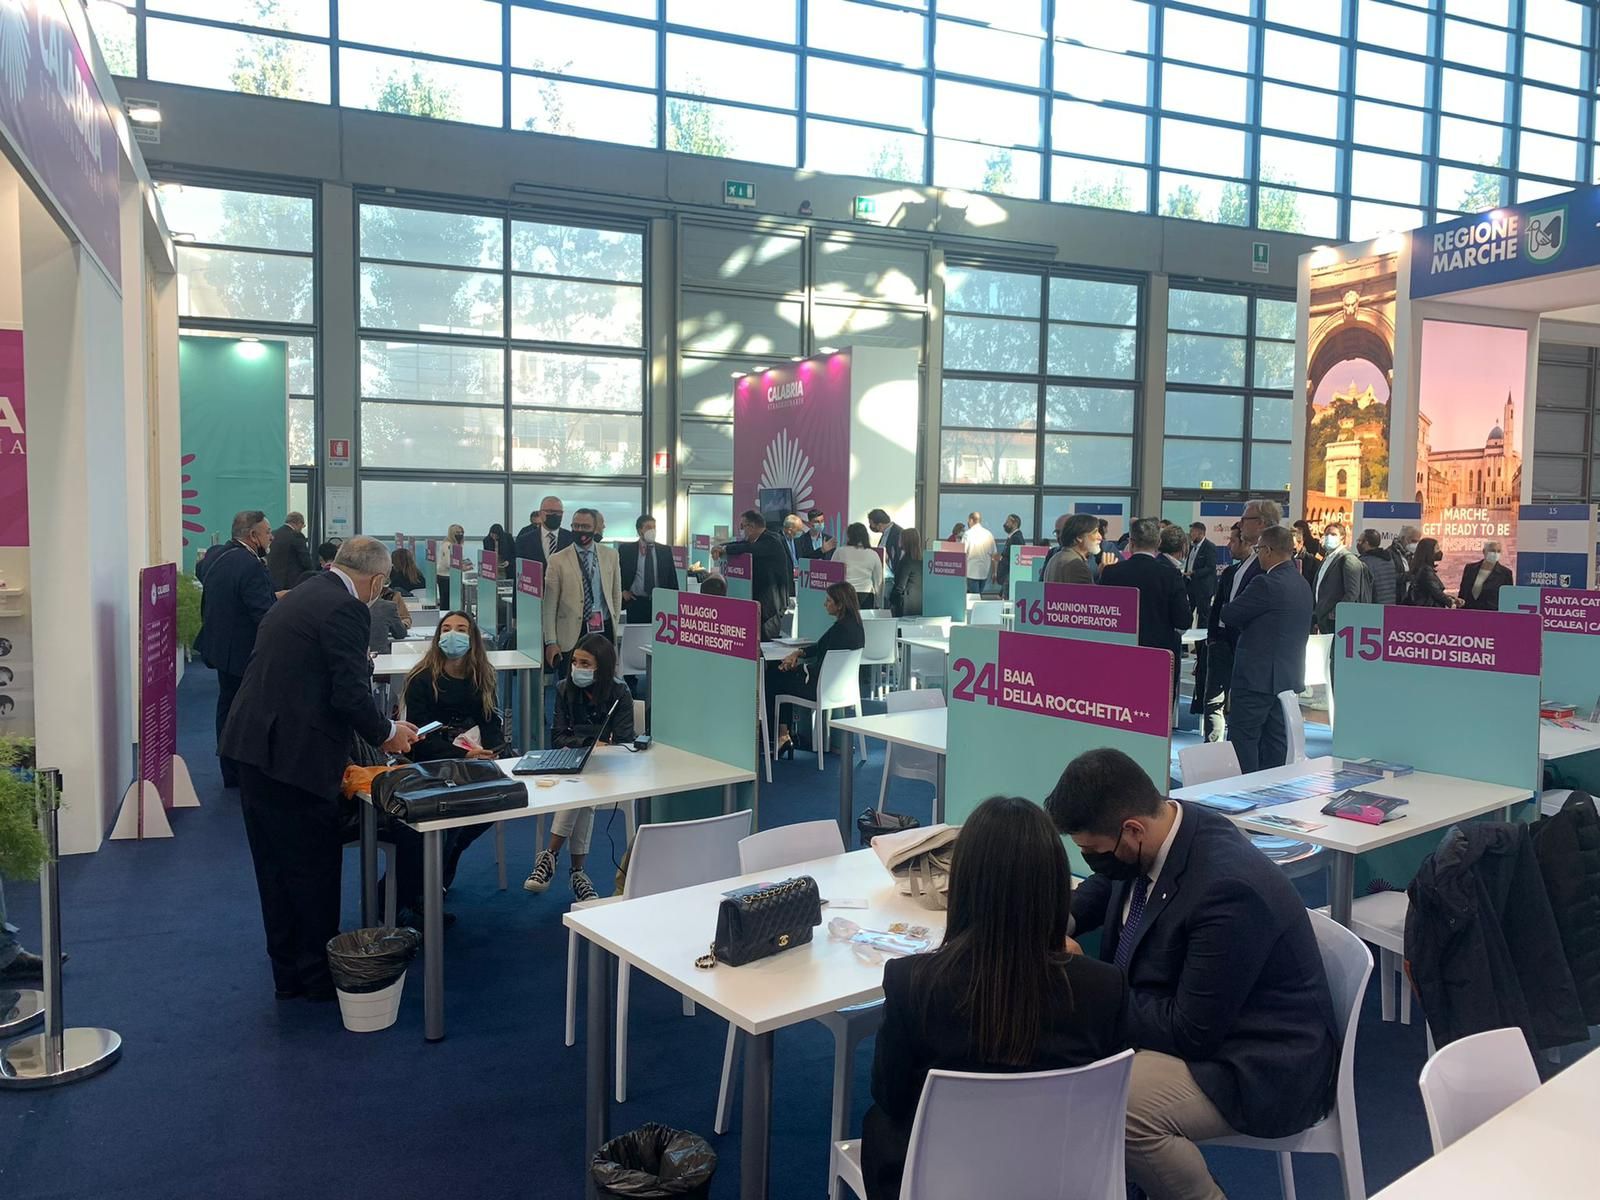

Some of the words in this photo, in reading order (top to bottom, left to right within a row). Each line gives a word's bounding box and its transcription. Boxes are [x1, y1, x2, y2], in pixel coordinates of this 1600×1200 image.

[1434, 215, 1519, 253] REGIONE
[1431, 238, 1518, 275] MARCHE
[768, 380, 804, 402] CALABRIA
[1321, 511, 1353, 523] MARC
[1443, 507, 1490, 522] MARCHE,
[1423, 523, 1441, 536] GET
[1444, 523, 1478, 536] READY
[1480, 523, 1494, 536] TO
[1497, 523, 1510, 536] BE
[927, 560, 934, 574] 9
[1530, 572, 1558, 580] REGIONE
[800, 569, 810, 588] 17
[1530, 578, 1558, 586] MARCHE
[1047, 601, 1088, 614] LAKINION
[1088, 604, 1122, 617] TRAVEL
[1544, 595, 1580, 607] SANTA
[680, 603, 718, 620] VILLAGGIO
[1016, 598, 1044, 626] 16
[1047, 612, 1070, 624] TOUR
[1070, 614, 1118, 628] OPERATOR
[1544, 606, 1587, 619] VILLAGE
[655, 610, 679, 646] 25
[680, 617, 697, 631] BAIA
[697, 620, 719, 635] DELLE
[720, 624, 747, 640] SIRENE
[1544, 618, 1584, 631] SCALEA
[680, 630, 704, 645] BEACH
[704, 634, 734, 651] RESORT
[1337, 625, 1383, 662] 15
[1388, 630, 1495, 650] ASSOCIAZIONE
[1388, 645, 1429, 660] LAGHI
[1431, 648, 1447, 662] DI
[1449, 650, 1496, 666] SIBARI
[952, 657, 998, 707] 24
[1003, 667, 1036, 687] BAIA
[1003, 687, 1044, 709] DELLA
[1045, 694, 1133, 724] ROCCHETTA
